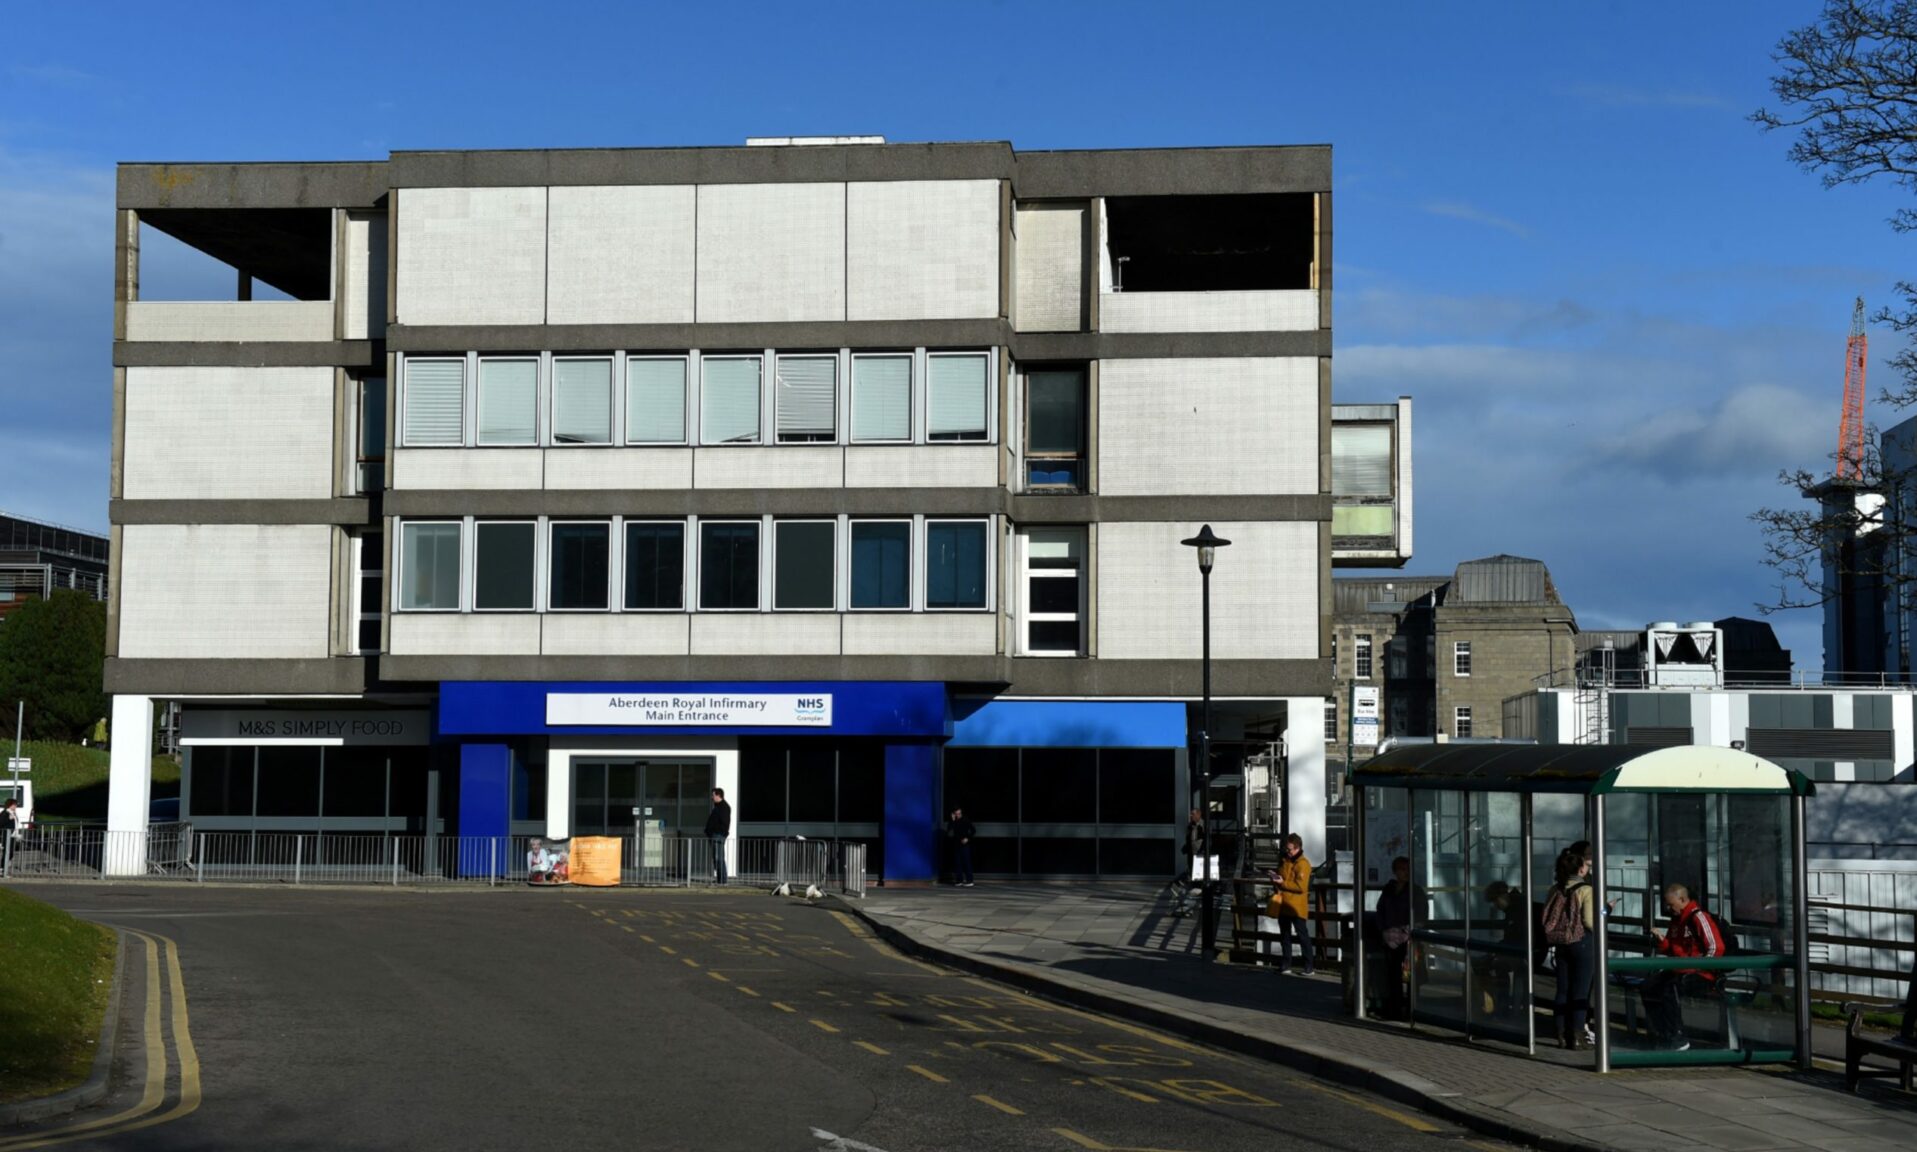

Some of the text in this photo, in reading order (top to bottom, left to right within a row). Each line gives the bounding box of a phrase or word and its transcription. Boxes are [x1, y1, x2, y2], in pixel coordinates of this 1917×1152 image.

[608, 697, 767, 712] Aberdeen Royal Infirmary
[797, 698, 824, 709] NHS
[645, 710, 729, 721] Main Entrance
[238, 720, 404, 735] M&S SIMPLY FOOD
